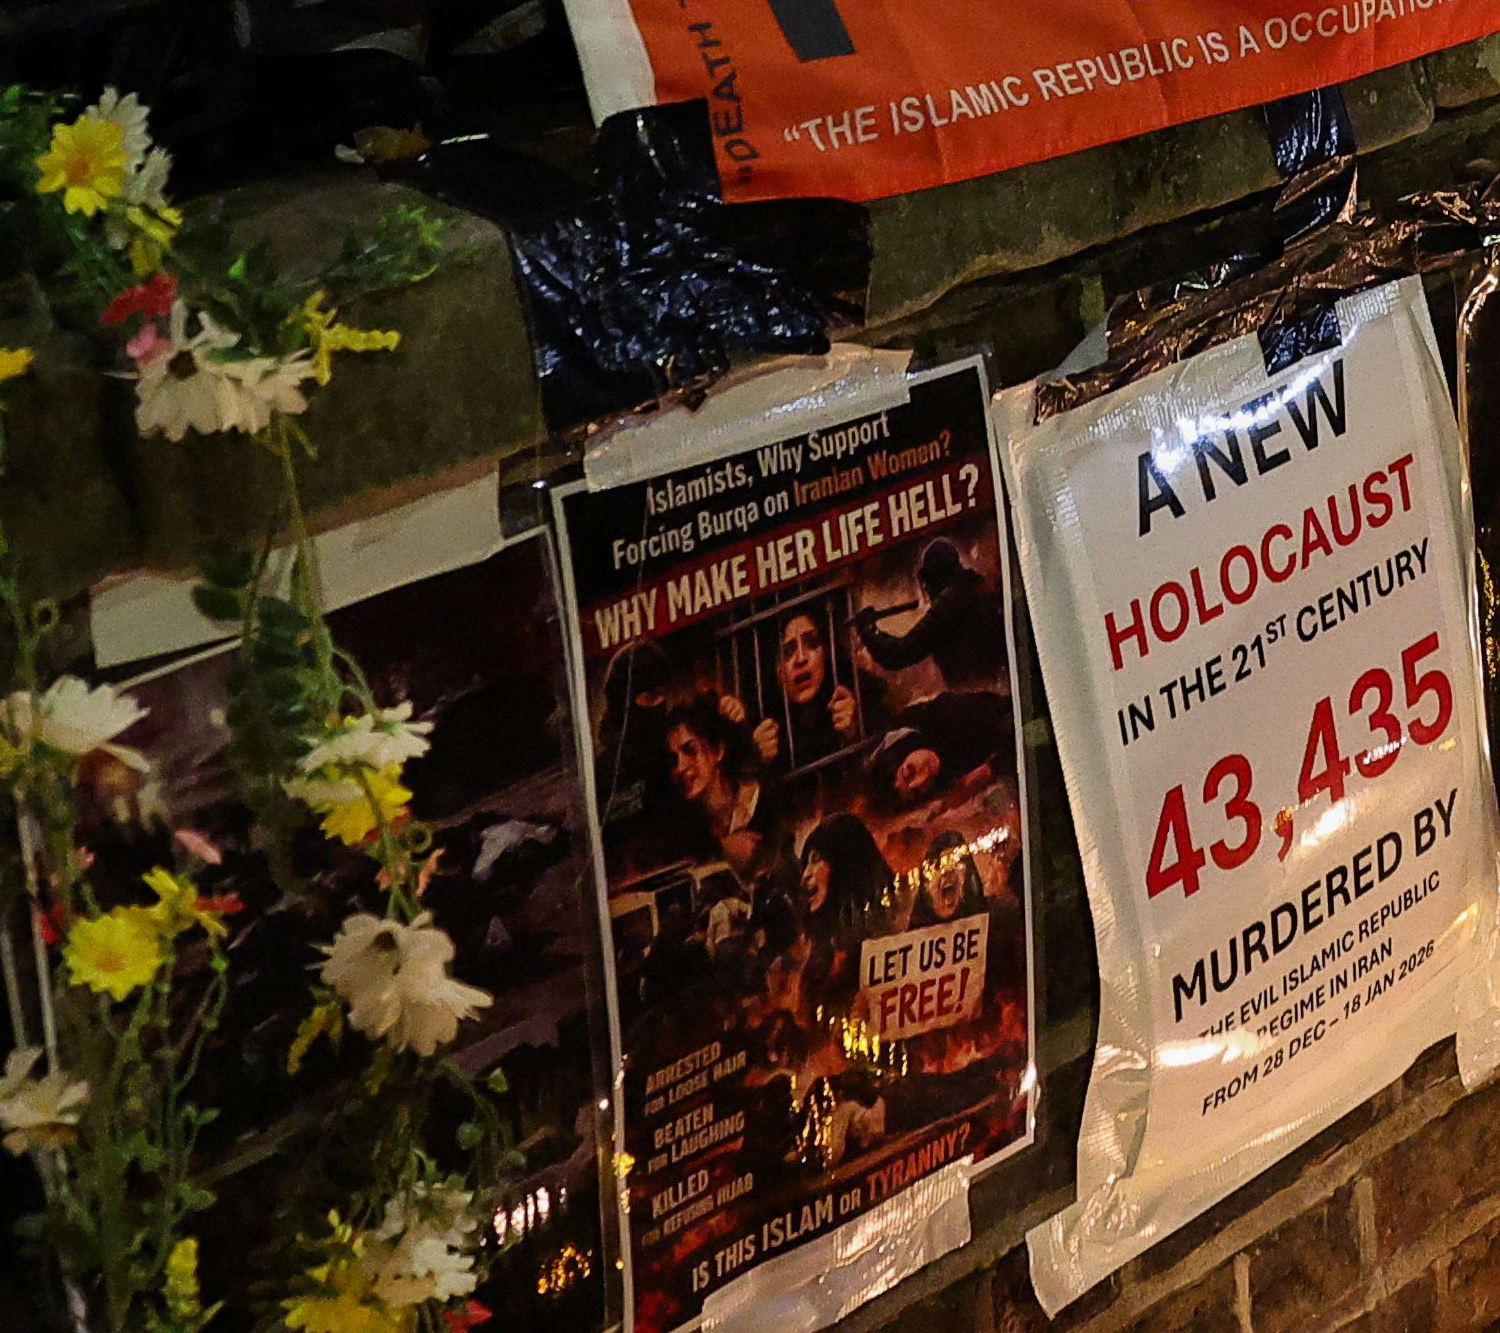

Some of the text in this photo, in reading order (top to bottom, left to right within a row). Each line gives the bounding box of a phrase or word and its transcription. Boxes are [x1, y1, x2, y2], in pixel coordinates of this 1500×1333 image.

[890, 75, 1031, 137] ISLAMIC
[1033, 36, 1195, 101] REPUBLIC
[1198, 30, 1231, 68] IS
[1238, 24, 1262, 59] A
[612, 428, 955, 571] Forcing Burqa on Iranian Women?
[648, 410, 892, 517] Islamists, Why Support
[1138, 358, 1348, 538] A NEW
[593, 462, 981, 652] WHY MAKE HER LIFE HELL?
[1104, 453, 1415, 672] HOLOCAUST
[1117, 536, 1430, 747] IN THE 21ST CENTURY
[1145, 630, 1455, 901] 43,435
[869, 927, 982, 989] LET US BE
[1171, 788, 1460, 1024] MURDERED BY
[1240, 988, 1280, 1026] EVIL
[1282, 929, 1356, 996] ISLAMIC
[1358, 869, 1441, 944] REPUBLIC
[880, 965, 972, 1035] FREE!
[1201, 938, 1436, 1117] FROM 28 DEC 18 JAN 2026
[1256, 937, 1394, 1040] REGIME IN IRAN
[645, 1039, 723, 1097] ARRESTED
[653, 1102, 715, 1150] BEATEN
[668, 1069, 710, 1106] LOOSE
[652, 1168, 710, 1219] KILLED
[671, 1109, 747, 1164] LAUGHING
[692, 1260, 711, 1293] IS
[714, 1234, 756, 1278] THIS
[762, 1194, 834, 1252] ISLAM
[867, 1121, 971, 1202] TYRANNY?
